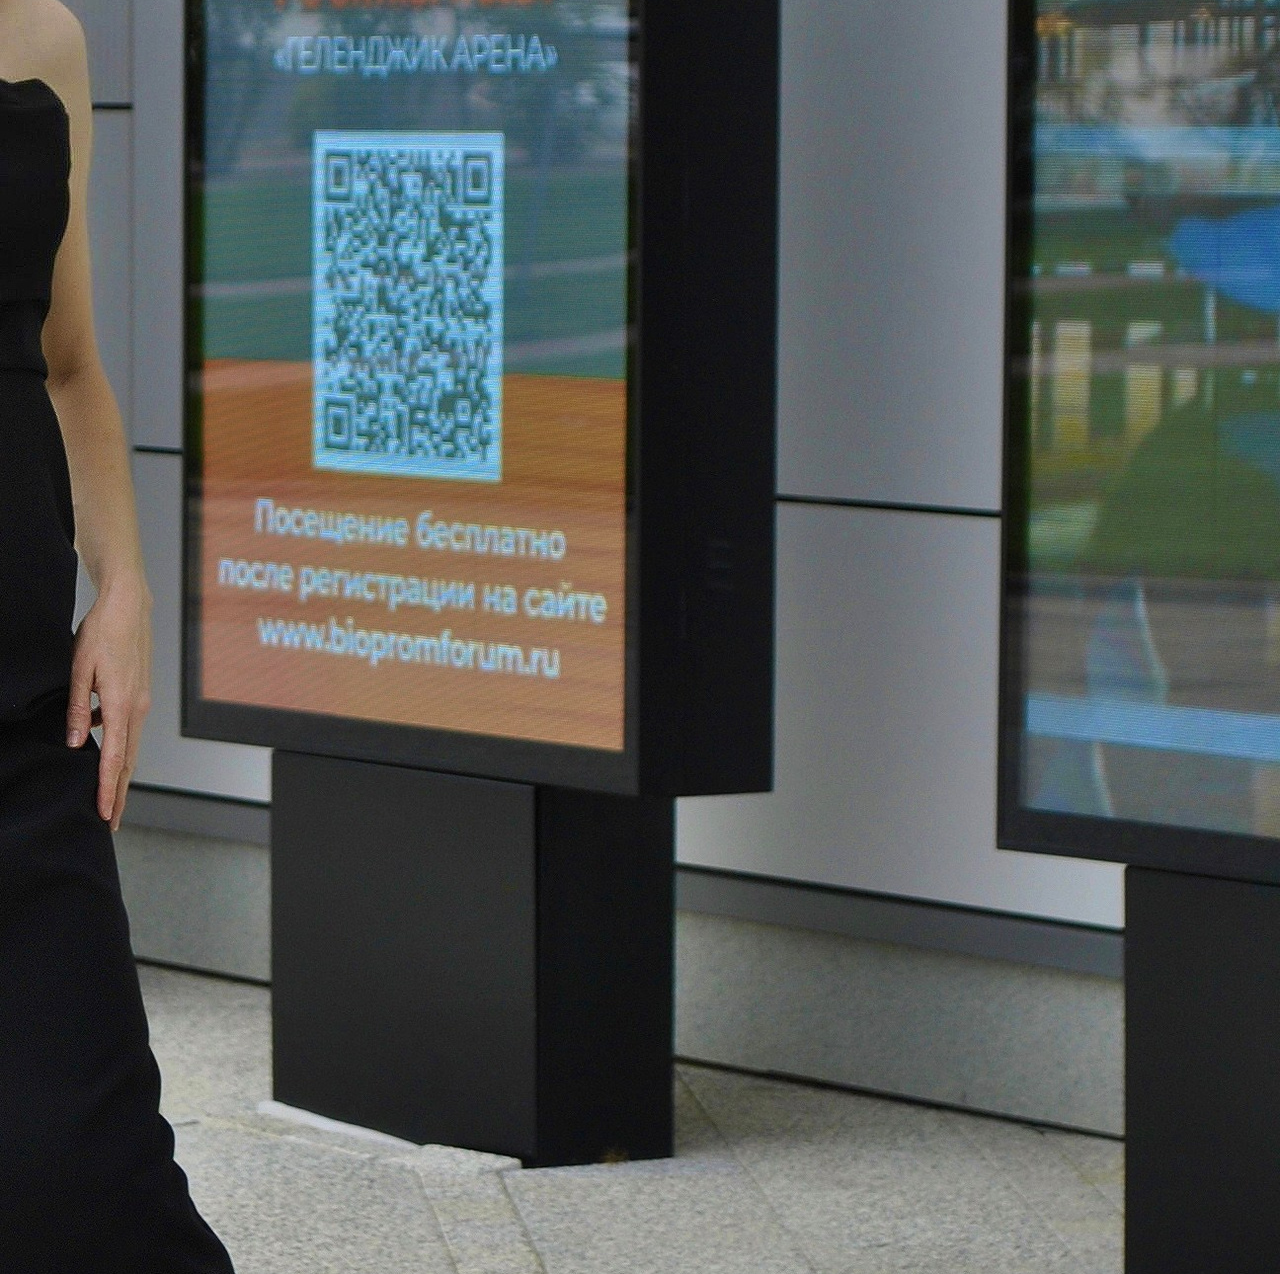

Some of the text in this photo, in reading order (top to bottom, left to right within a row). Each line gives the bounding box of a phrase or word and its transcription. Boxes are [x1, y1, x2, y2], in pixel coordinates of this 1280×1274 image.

[272, 34, 560, 79] «ГЕЛЕНДЖИК АРЕНА»
[254, 497, 567, 561] Посещение бесплатно
[217, 557, 609, 624] после регистрации на сайте
[255, 615, 562, 680] www.biopromforum.ru
